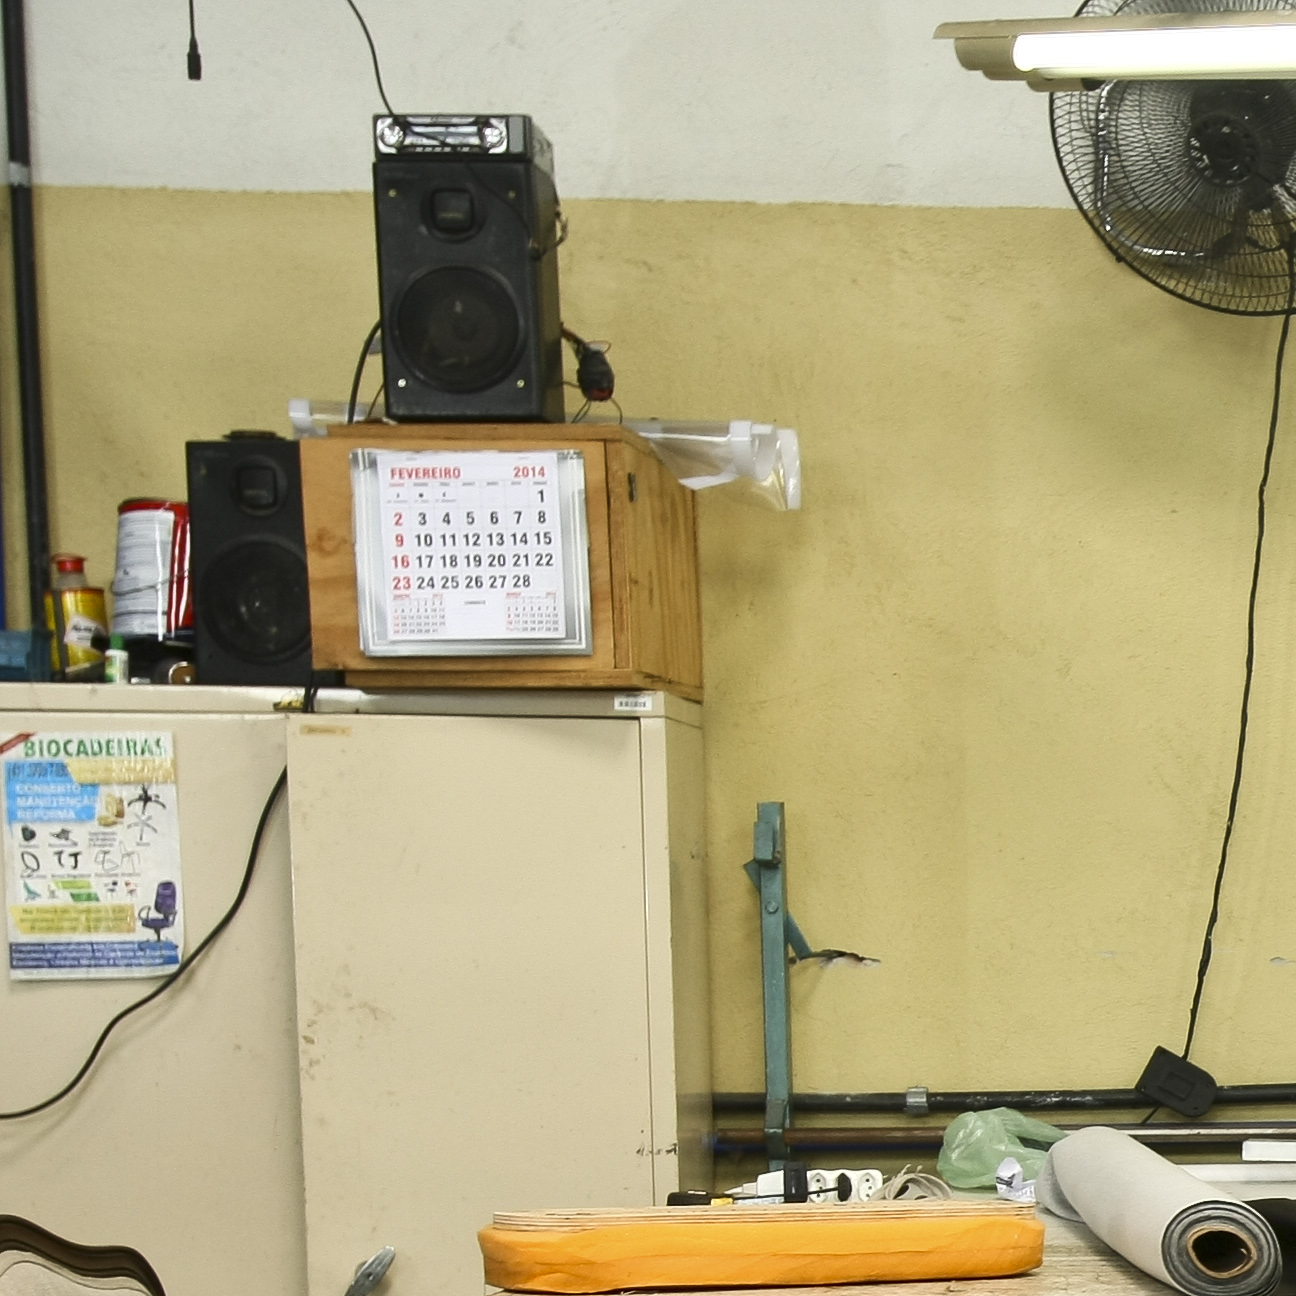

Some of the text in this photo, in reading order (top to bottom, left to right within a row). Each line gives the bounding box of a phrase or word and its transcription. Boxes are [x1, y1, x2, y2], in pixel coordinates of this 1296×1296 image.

[390, 465, 546, 480] FEVEREIRO 2014
[537, 488, 545, 503] 1
[393, 510, 547, 527] 2 3 4 5 6 7 8
[395, 531, 553, 548] 9 10 11 12 13 14 15
[392, 552, 554, 569] 16 17 18 19 20 21 22
[392, 573, 531, 591] 23 24 25 26 27 28
[24, 738, 166, 757] BIOCADEIRAS
